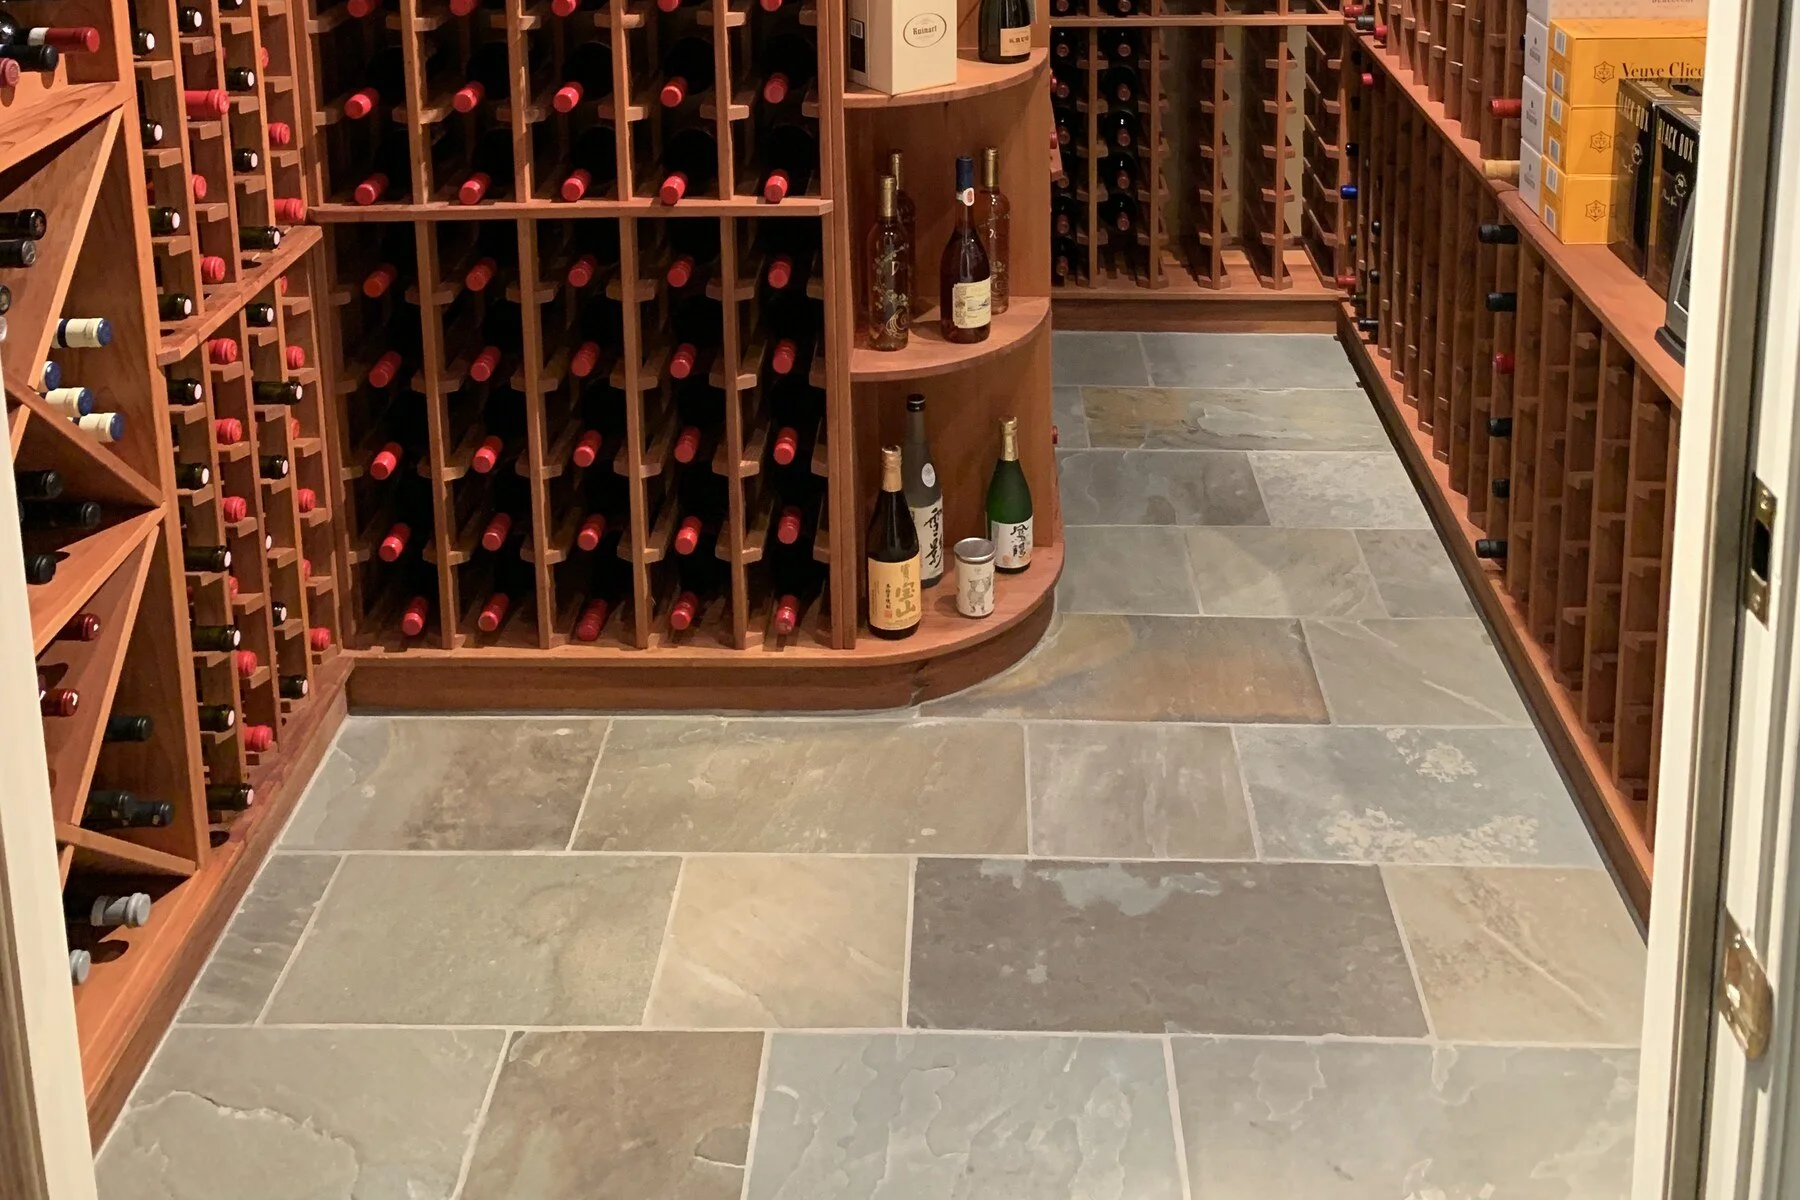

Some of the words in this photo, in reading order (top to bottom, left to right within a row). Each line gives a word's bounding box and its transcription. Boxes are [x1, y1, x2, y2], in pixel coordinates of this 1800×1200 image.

[1621, 62, 1664, 78] Veuve
[1635, 105, 1650, 133] BOX
[1658, 118, 1678, 152] BLACK
[1678, 133, 1695, 164] BOX
